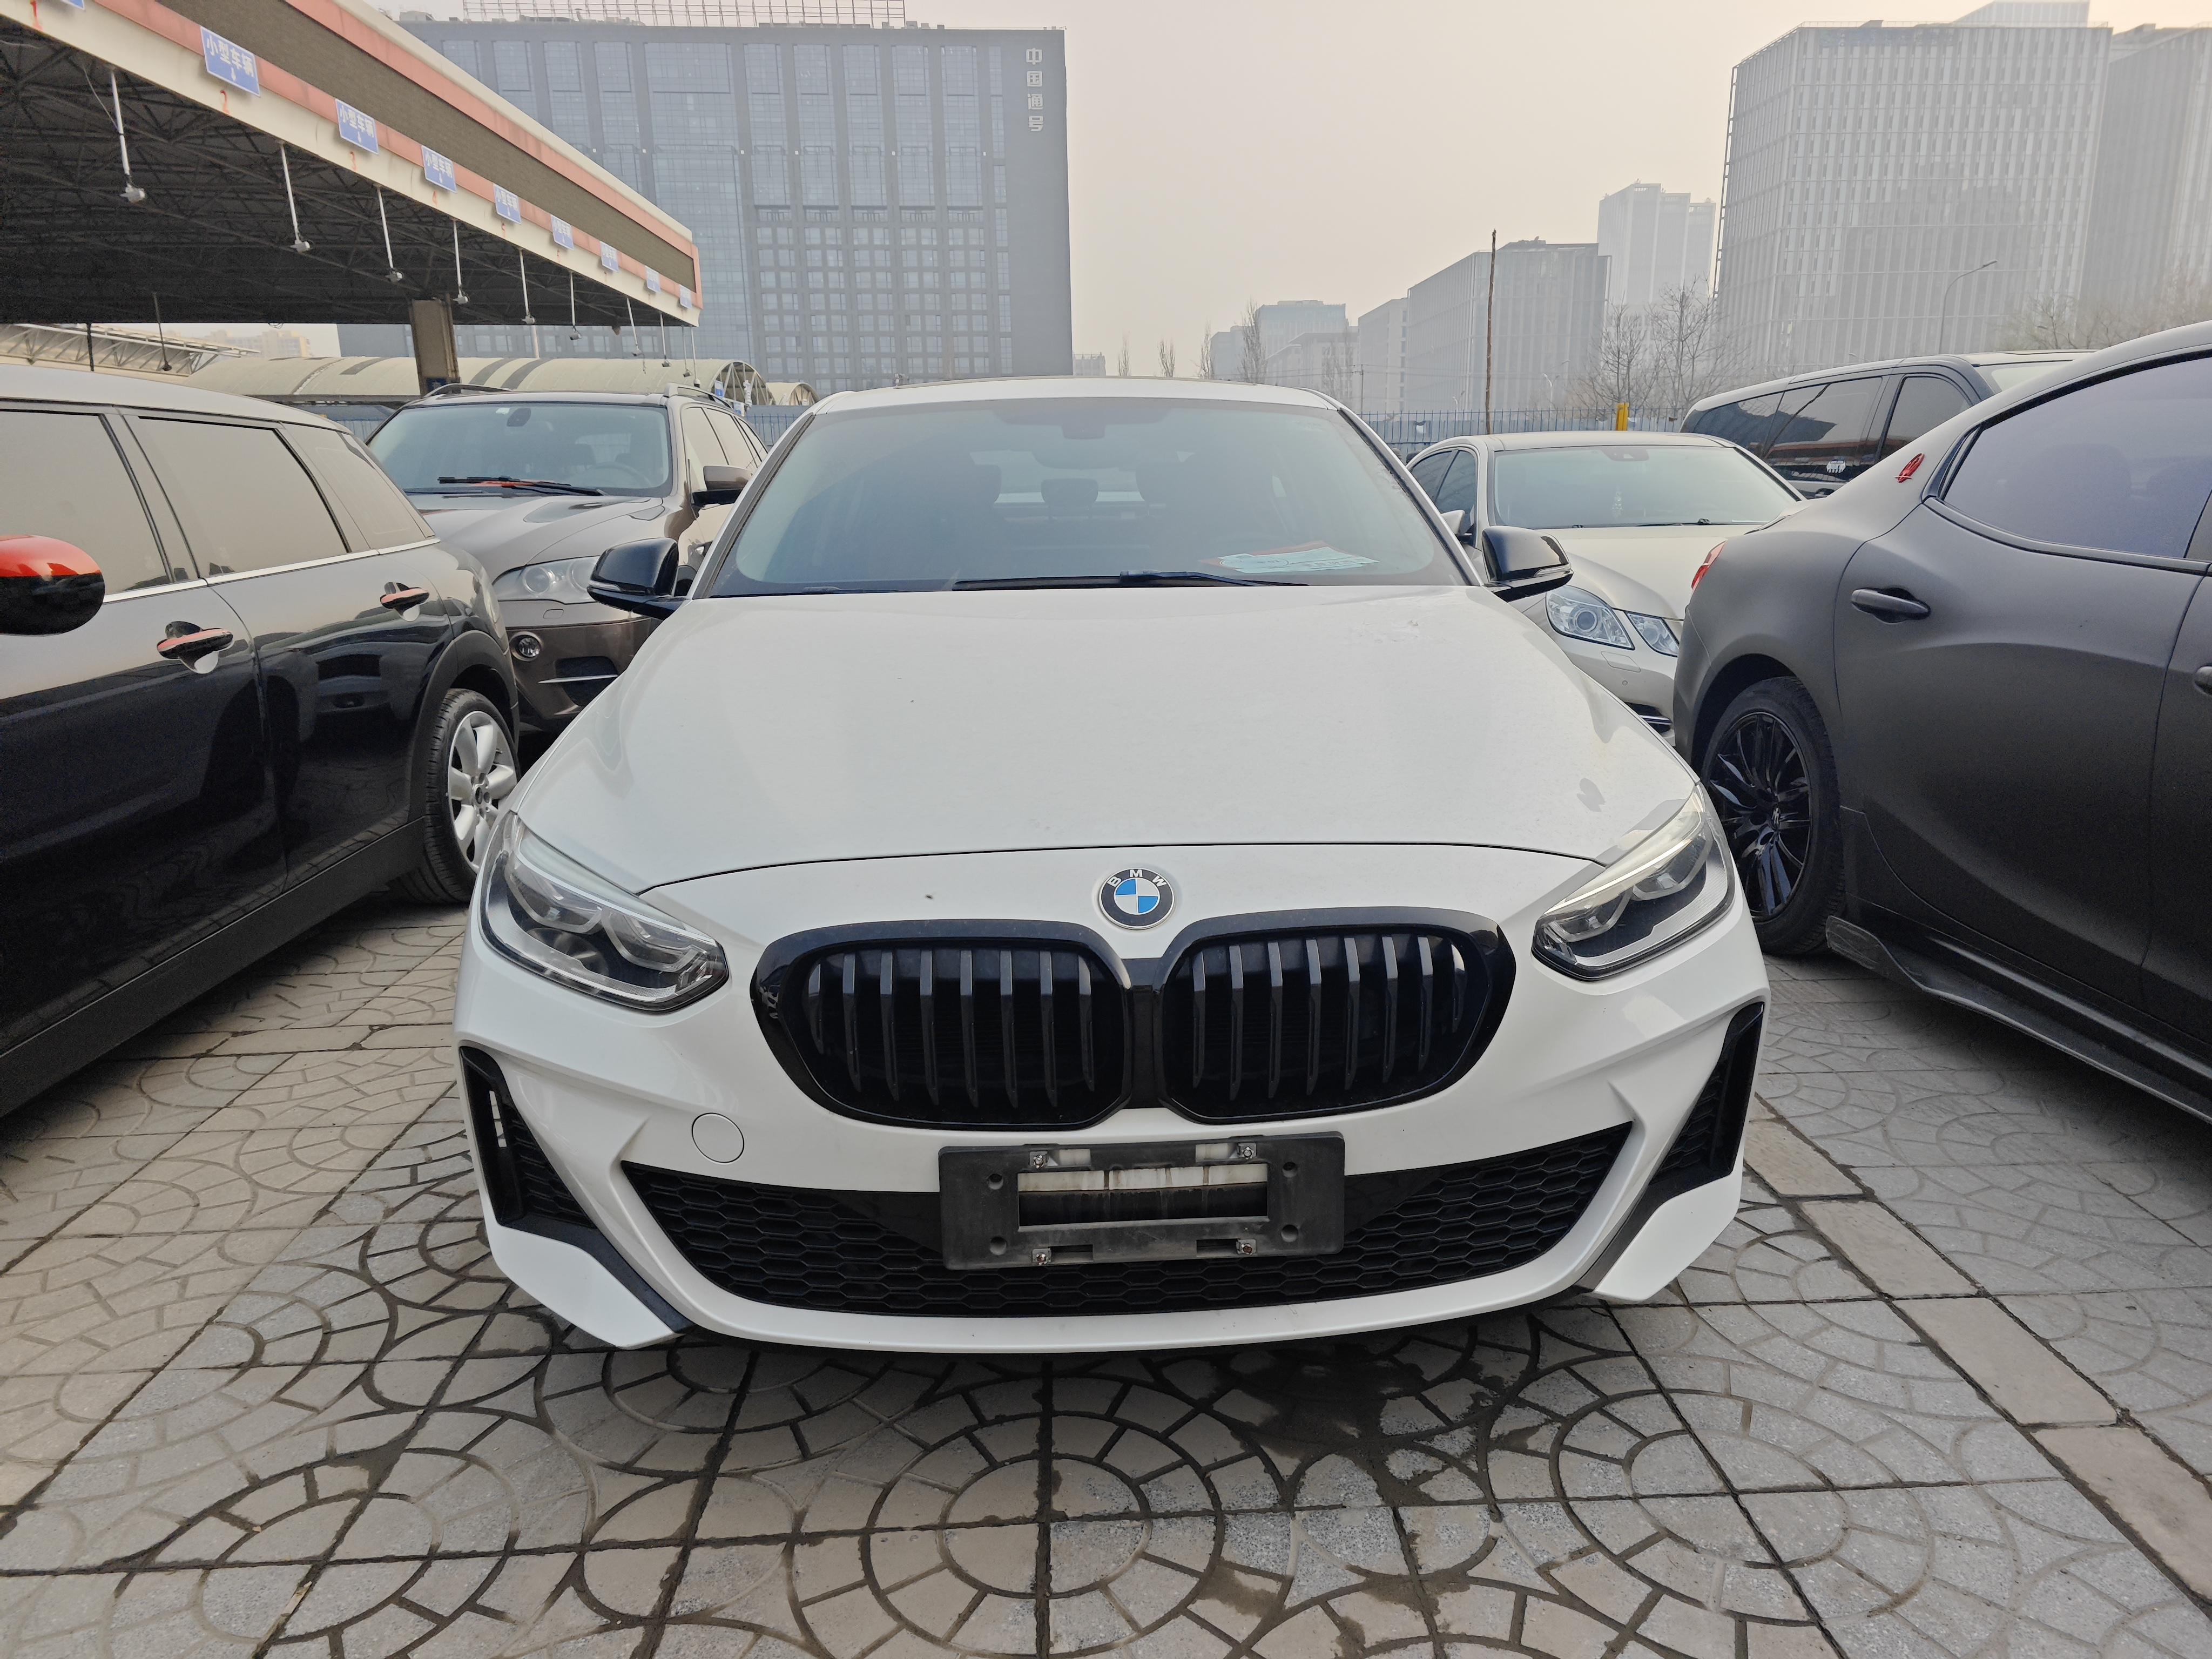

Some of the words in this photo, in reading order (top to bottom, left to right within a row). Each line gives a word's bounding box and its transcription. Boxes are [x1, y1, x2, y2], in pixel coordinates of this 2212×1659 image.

[207, 35, 254, 77] 小型车辆
[1026, 48, 1044, 132] 中国通号
[340, 105, 374, 138] 小型车辆
[425, 151, 453, 178] 小型车辆
[1107, 869, 1167, 887] BMW
